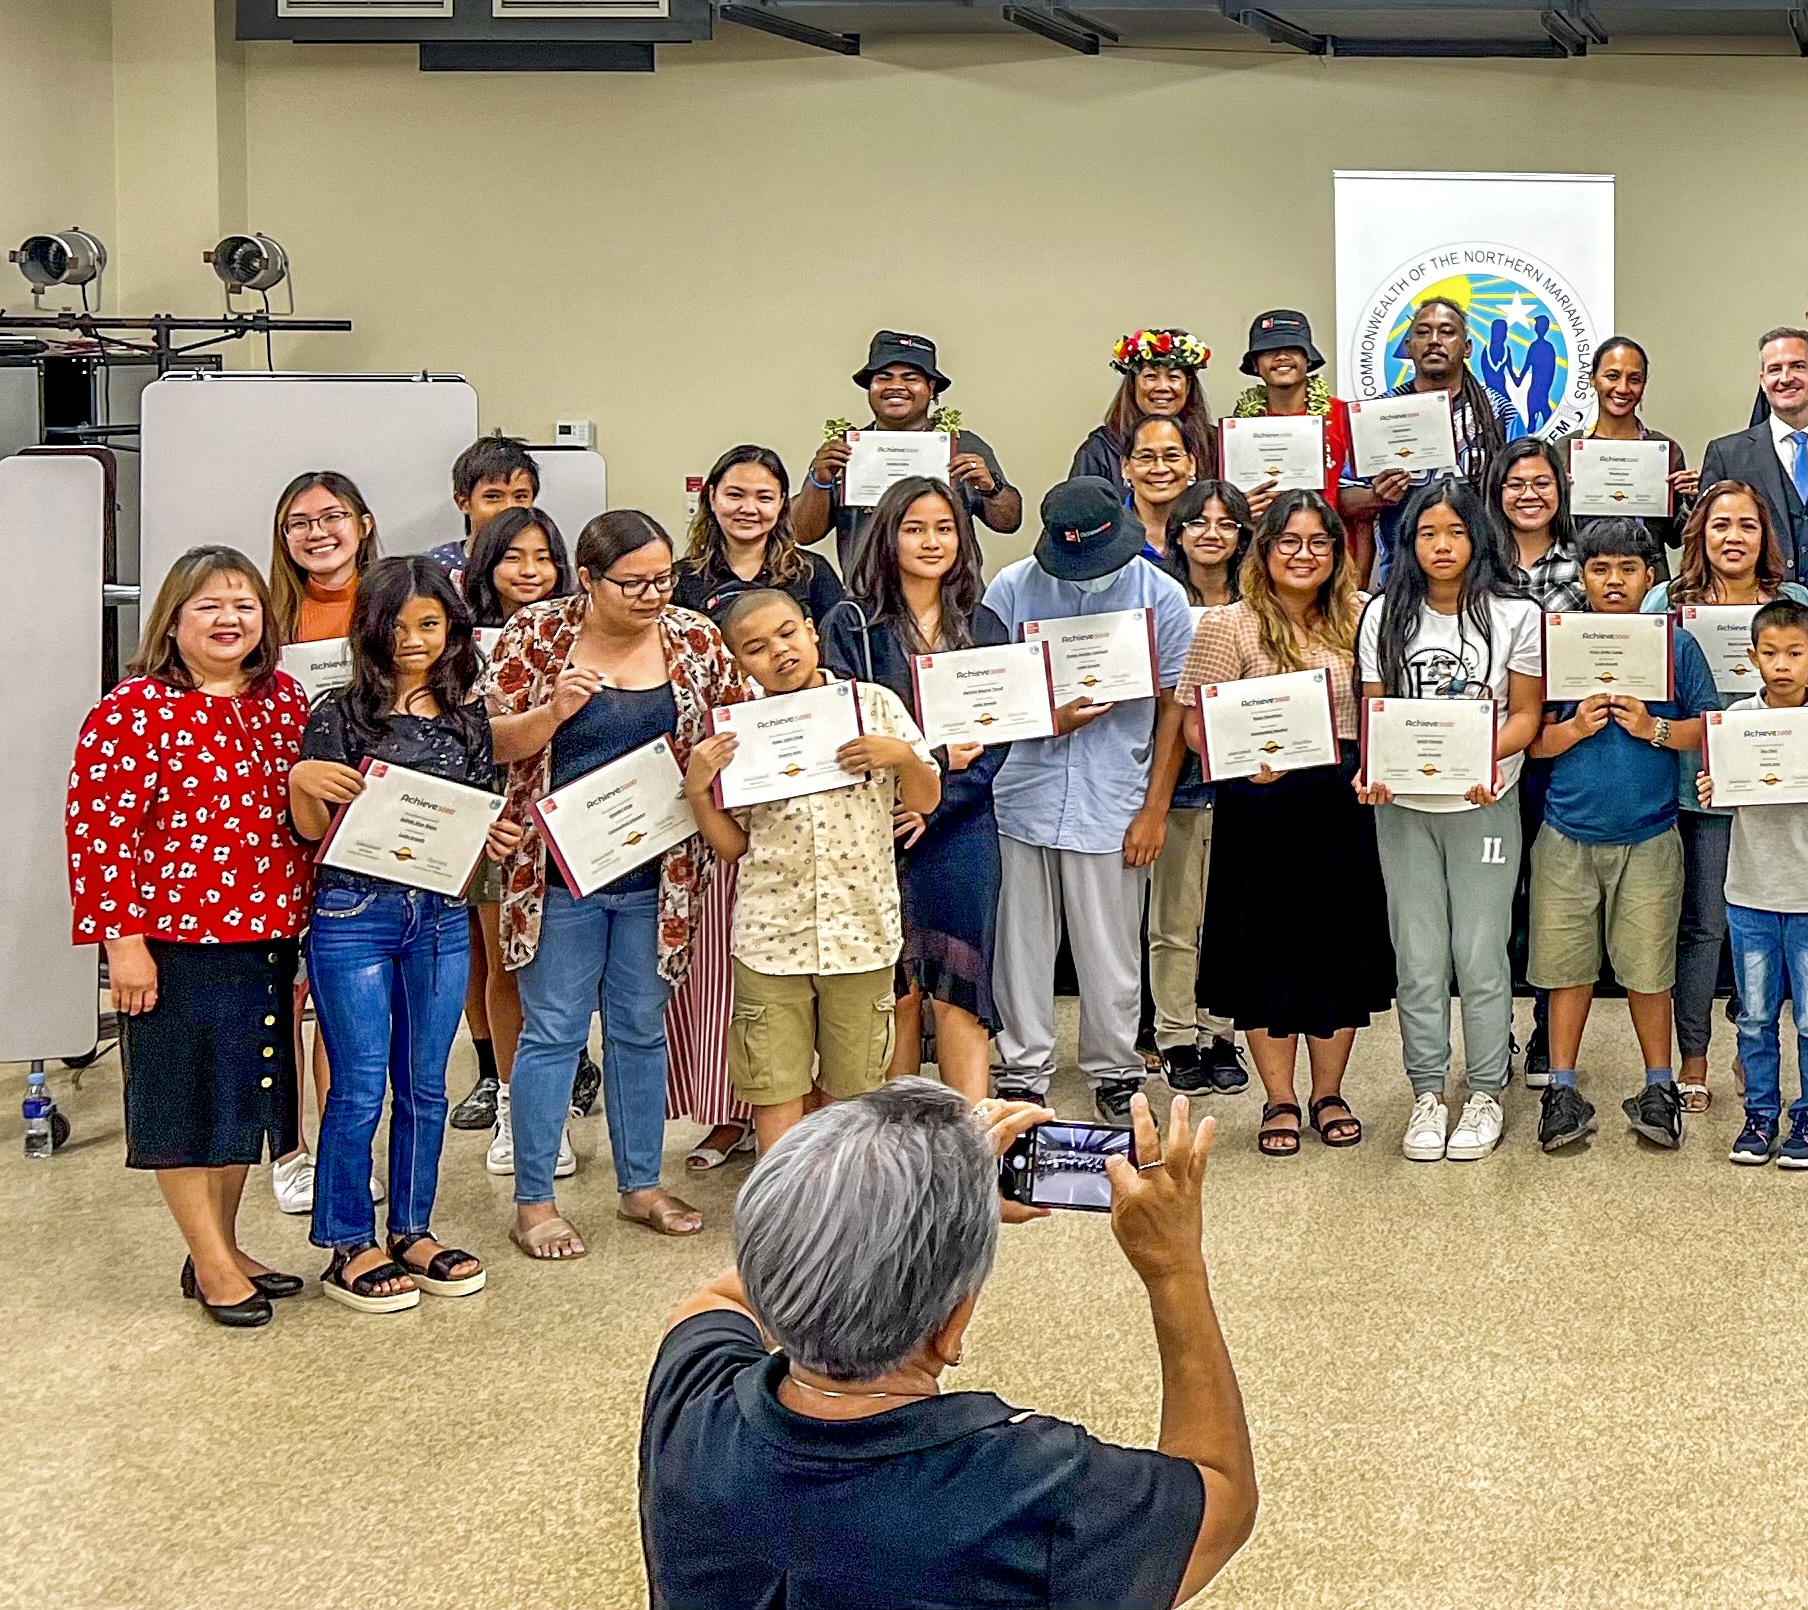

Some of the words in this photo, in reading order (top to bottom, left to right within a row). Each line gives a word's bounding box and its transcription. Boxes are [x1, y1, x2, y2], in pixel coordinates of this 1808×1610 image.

[1361, 278, 1409, 396] COMMONWEALTH
[1409, 263, 1427, 281] OF
[1430, 252, 1460, 270] THE
[1464, 250, 1544, 282] NORTHERN
[1542, 277, 1586, 337] MARIANA
[1574, 338, 1591, 400] ISLANDS
[1481, 836, 1507, 864] IL
